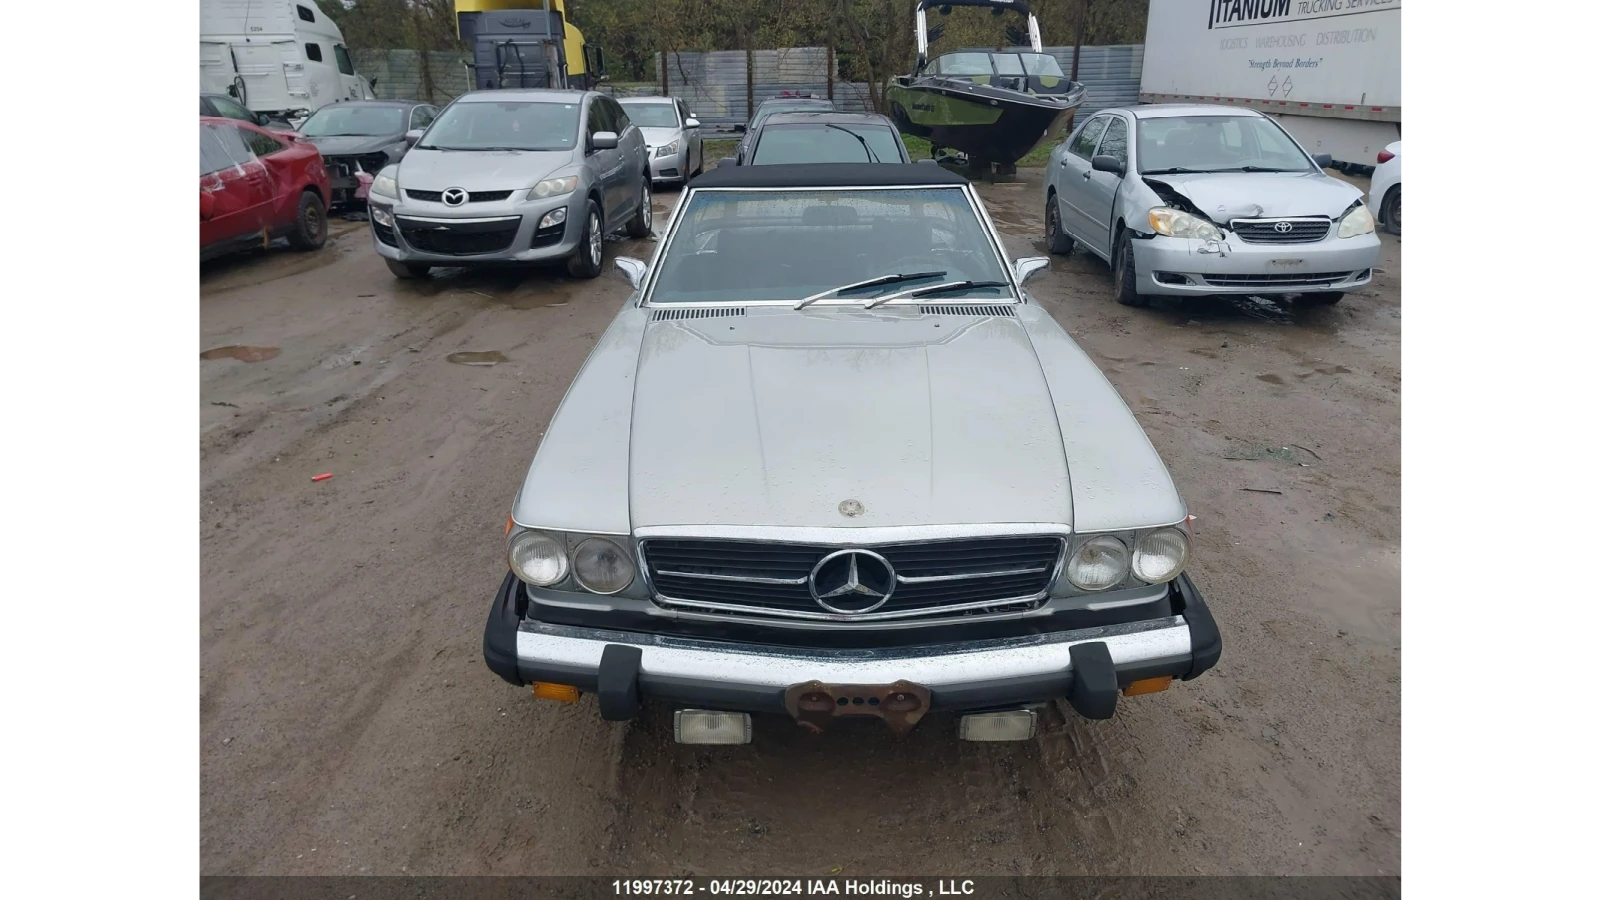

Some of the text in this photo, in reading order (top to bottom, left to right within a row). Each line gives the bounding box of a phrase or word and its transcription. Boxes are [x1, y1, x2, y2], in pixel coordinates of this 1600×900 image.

[1208, 0, 1393, 29] TITANIUM TRUCKING SERVI
[1220, 27, 1378, 50] LOGISTICS WAREHOUSING DISTRIBUTION
[1272, 58, 1293, 71] Beyond
